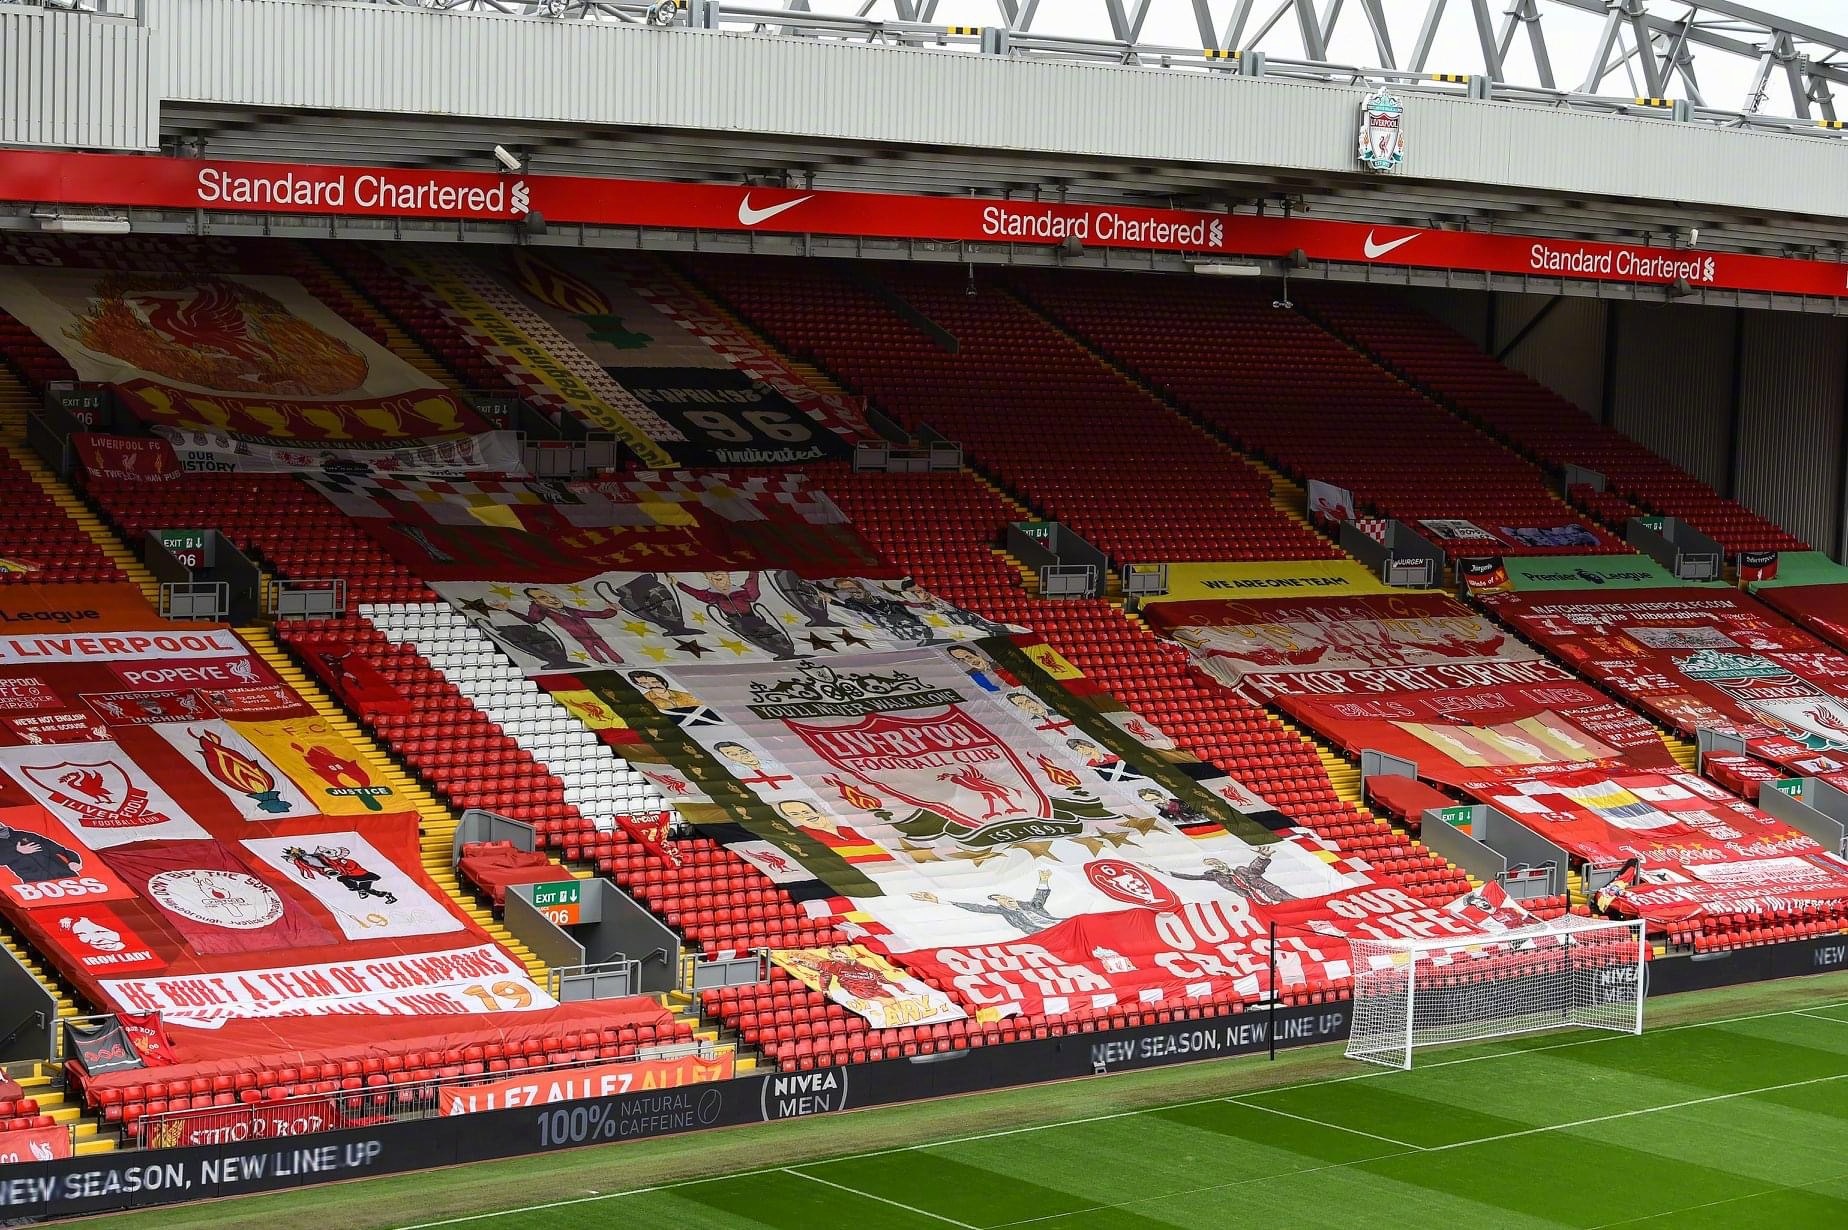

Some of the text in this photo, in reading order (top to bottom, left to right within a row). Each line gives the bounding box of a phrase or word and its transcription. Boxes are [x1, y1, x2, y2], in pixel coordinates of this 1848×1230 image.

[1370, 118, 1398, 128] LIVERPOOL
[198, 168, 504, 211] Standard Chartered
[982, 207, 1204, 244] Standard Chartered
[1530, 244, 1700, 280] Standard Chartered
[682, 410, 813, 443] 96
[91, 437, 160, 451] LIVERPOOL FC
[180, 461, 236, 473] ISTORY
[188, 451, 214, 461] OUR
[164, 471, 181, 481] PUB
[163, 539, 182, 548] EXIT
[1201, 575, 1350, 590] WE ARE ONE TEAM
[1521, 571, 1653, 583] Premier League
[0, 609, 100, 623] League
[9, 635, 234, 657] LIVERPOOL
[0, 678, 46, 688] RPOOL
[125, 665, 230, 685] POPEYE
[1232, 660, 1574, 706] THE KOP SPIRIT SURVIVES
[101, 691, 179, 702] LIVERPOOL
[1420, 692, 1515, 715] LEGACY
[1520, 688, 1594, 703] LIVES
[1734, 686, 1813, 699] LIVERPOOL
[763, 692, 961, 718] YOU'LL NEVER WALK ALONE
[37, 716, 55, 724] NOT
[55, 713, 87, 723] ENGLISH
[814, 720, 989, 759] LIVERPOOL
[851, 748, 1001, 772] FOOTBALL CLUB
[331, 786, 389, 797] JUSTICE
[93, 816, 160, 827] FOOTBALL CLUB
[1442, 813, 1456, 821] EXIT
[989, 824, 1069, 843] EST 1892
[11, 877, 109, 901] BOSS
[205, 871, 239, 880] THE
[244, 878, 272, 894] SUN
[536, 893, 557, 904] EXIT
[936, 889, 1426, 976] OUR OUR OUR
[81, 950, 153, 966] IRON LADY
[1153, 938, 1326, 978] CREST
[1814, 945, 1845, 966] NEW
[115, 981, 165, 1010] HE
[156, 978, 239, 1007] BUILT
[237, 975, 269, 1001] A
[258, 969, 340, 1001] TEAM
[330, 966, 373, 993] OF
[366, 948, 510, 990] CHAMPIONS
[462, 981, 533, 1011] 19
[1090, 1013, 1344, 1063] NEW SEASON, NEW LINE UP
[450, 1065, 723, 1116] ALLEZ ALLEZ ALLEZ
[773, 1071, 839, 1098] NIVEA
[622, 1094, 692, 1117] NATURAL
[779, 1094, 830, 1119] MEN
[537, 1103, 694, 1147] 100% CAFFEINE
[64, 1162, 193, 1200] SEASON,
[200, 1153, 268, 1186] NEW
[273, 1145, 339, 1177] LINE
[345, 1140, 383, 1171] UP
